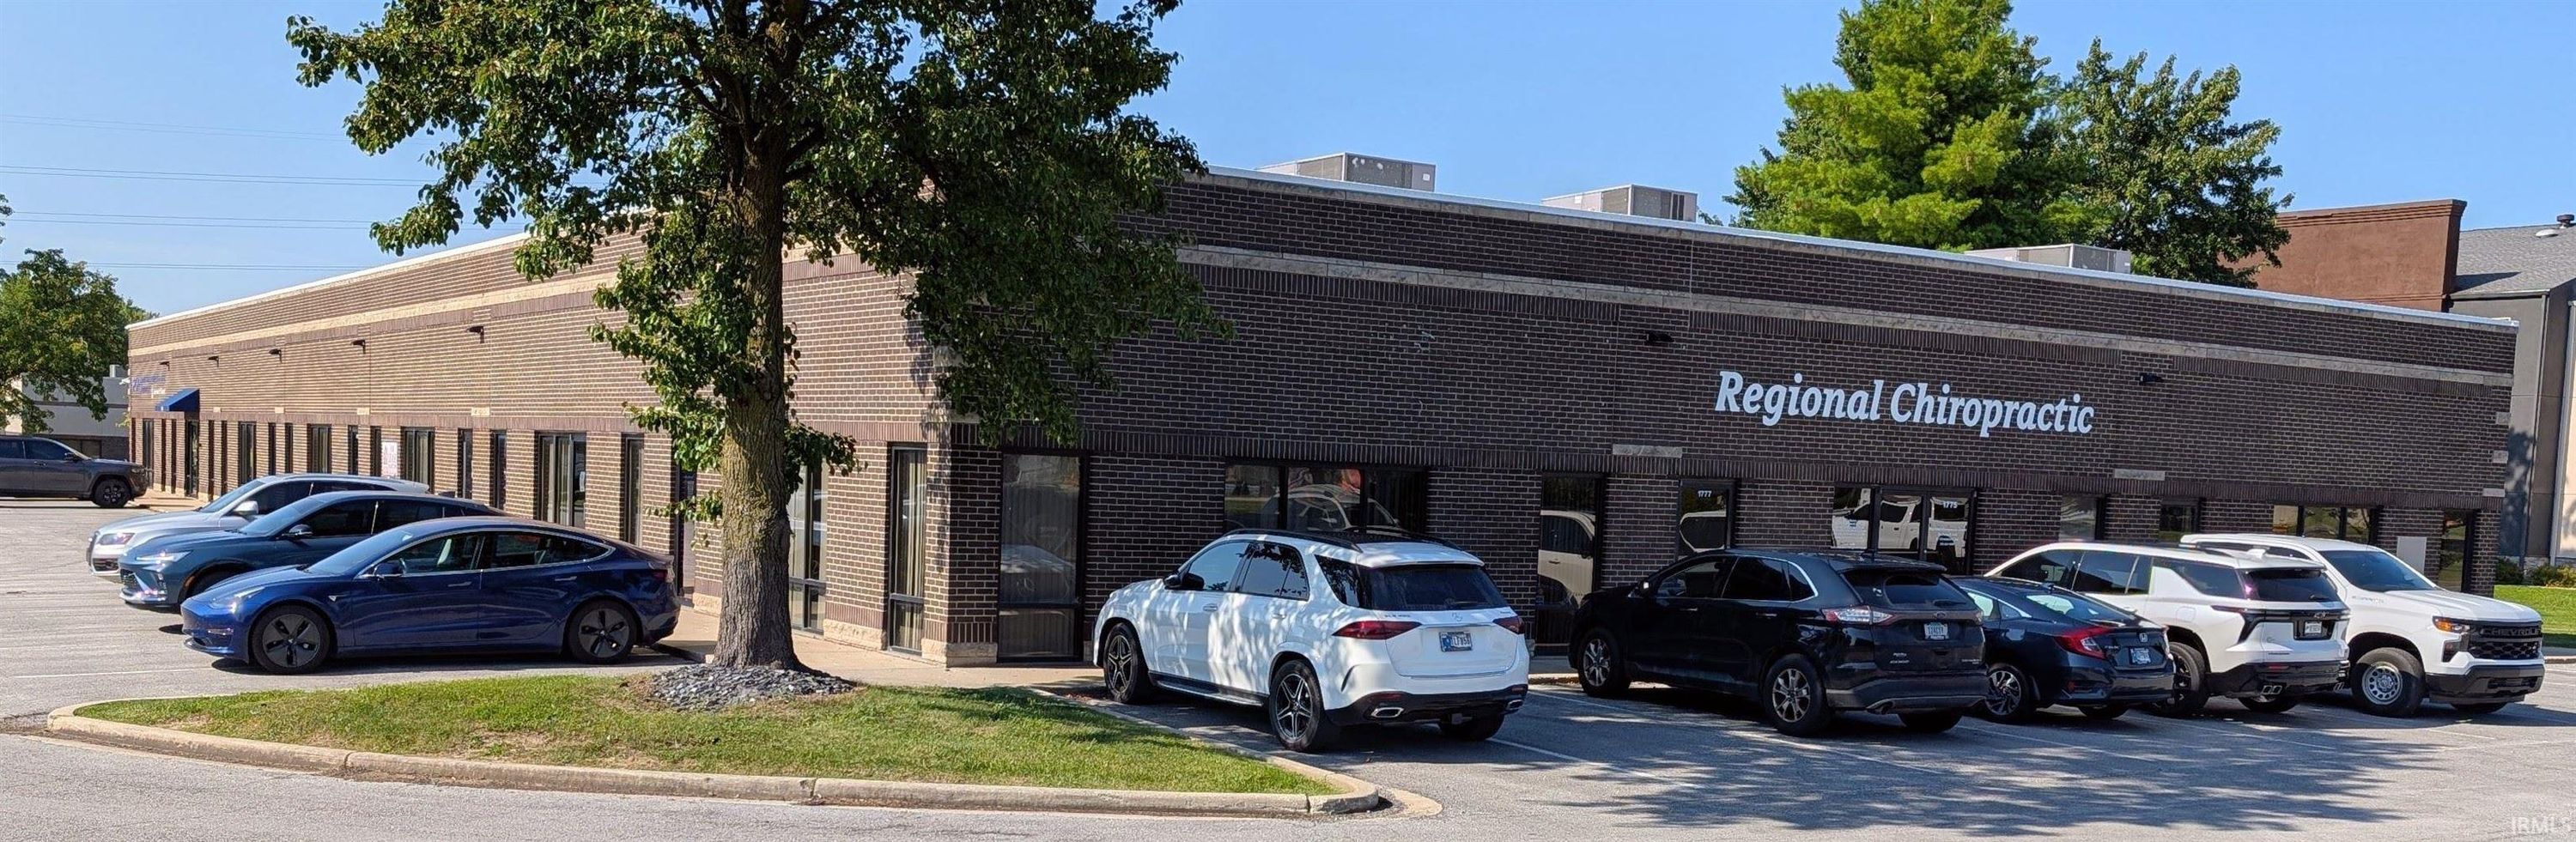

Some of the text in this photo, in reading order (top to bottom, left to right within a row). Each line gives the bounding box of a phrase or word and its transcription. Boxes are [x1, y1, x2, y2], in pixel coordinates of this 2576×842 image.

[1715, 371, 2095, 438] Regional Chiropractic
[2480, 627, 2539, 636] CHEVROLE
